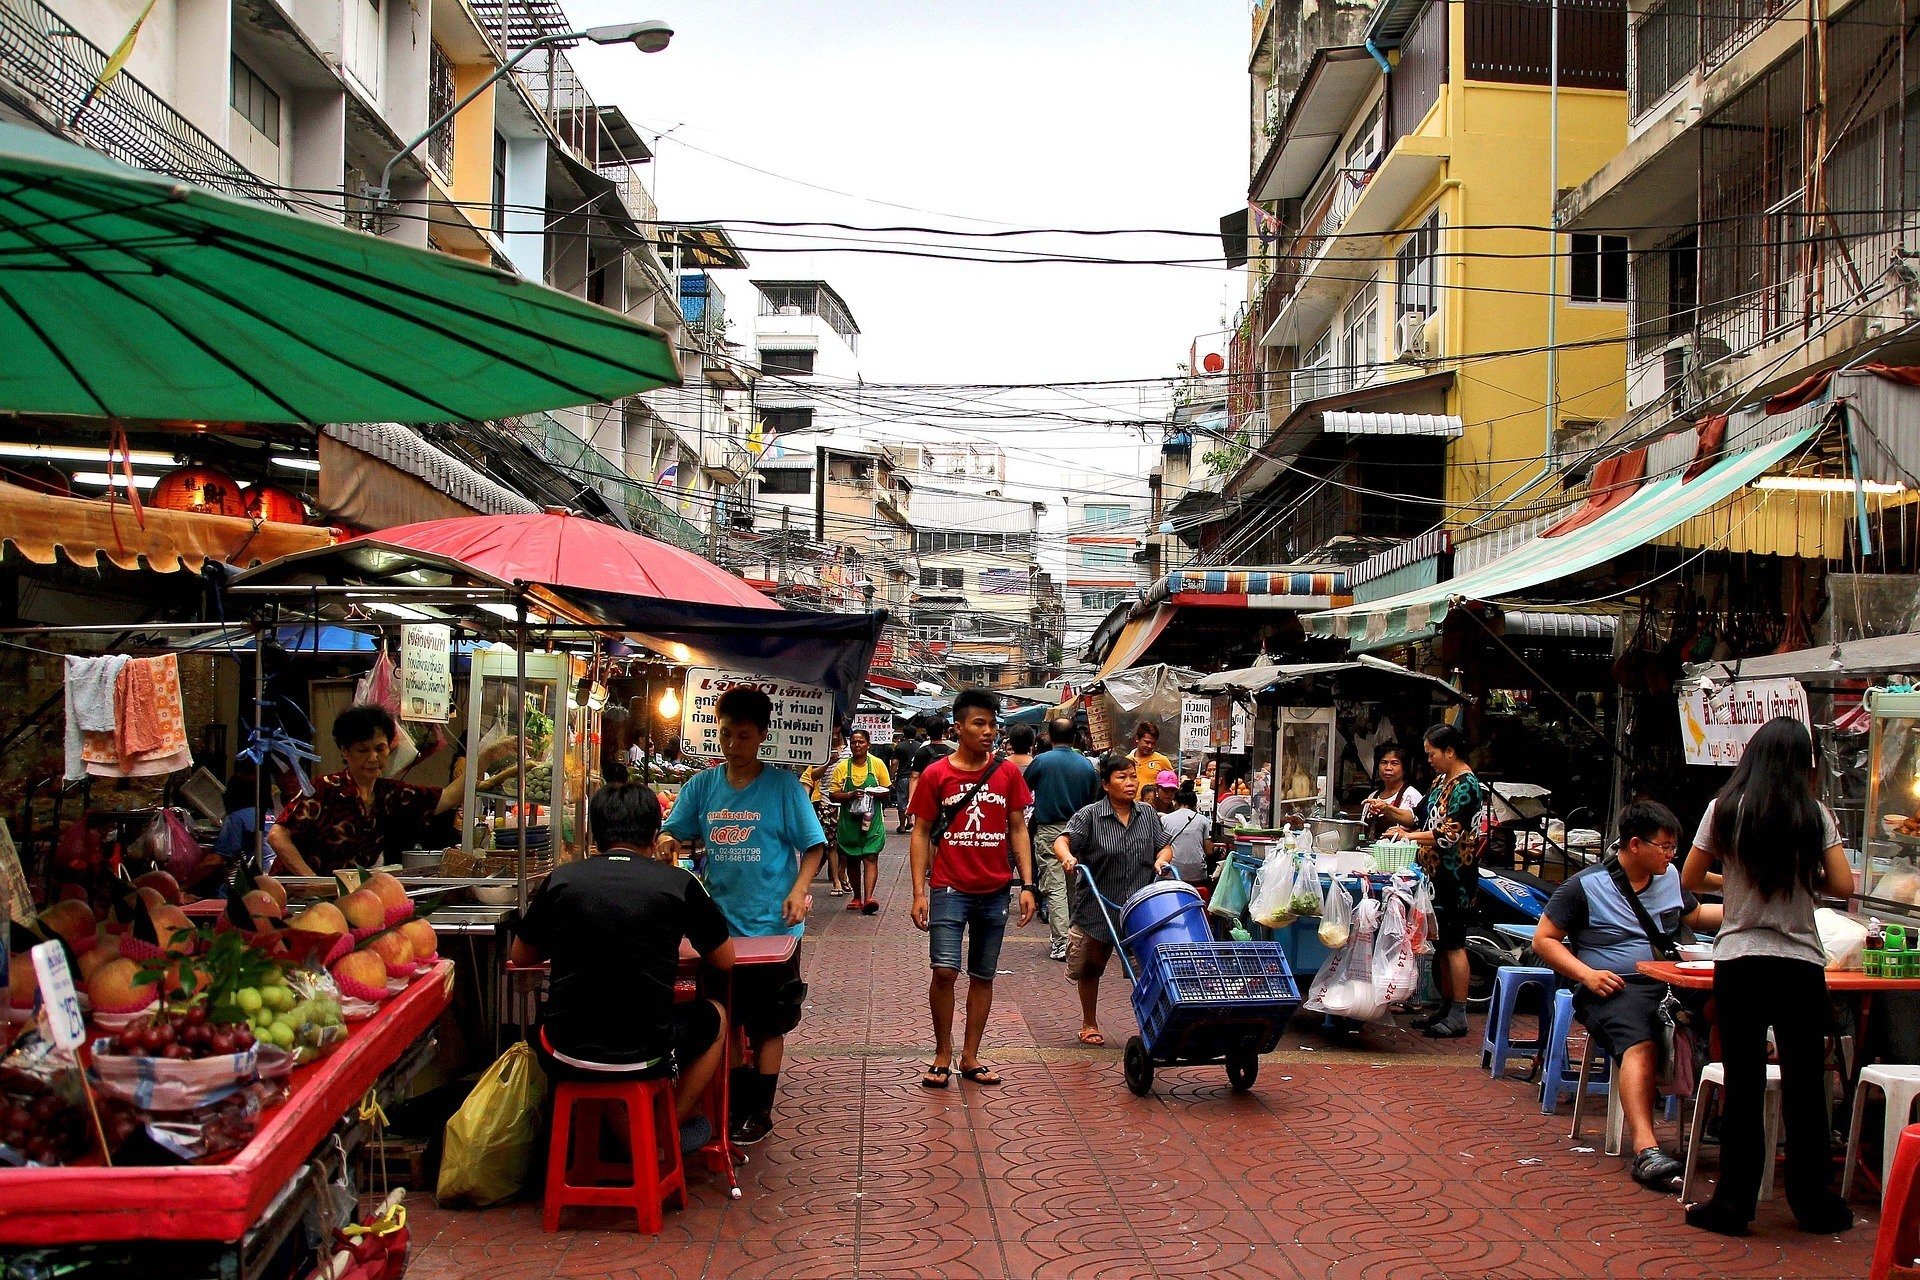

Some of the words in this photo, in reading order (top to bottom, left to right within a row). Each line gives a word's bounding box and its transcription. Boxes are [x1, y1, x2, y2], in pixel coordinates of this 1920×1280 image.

[790, 700, 824, 715] ทำเอง
[789, 735, 813, 746] บาท
[760, 747, 772, 757] 50
[788, 749, 812, 760] บาท
[959, 784, 964, 792] I
[965, 783, 990, 792] RN
[943, 831, 952, 840] O
[953, 832, 975, 840] MEET
[975, 832, 1006, 841] WOMEN
